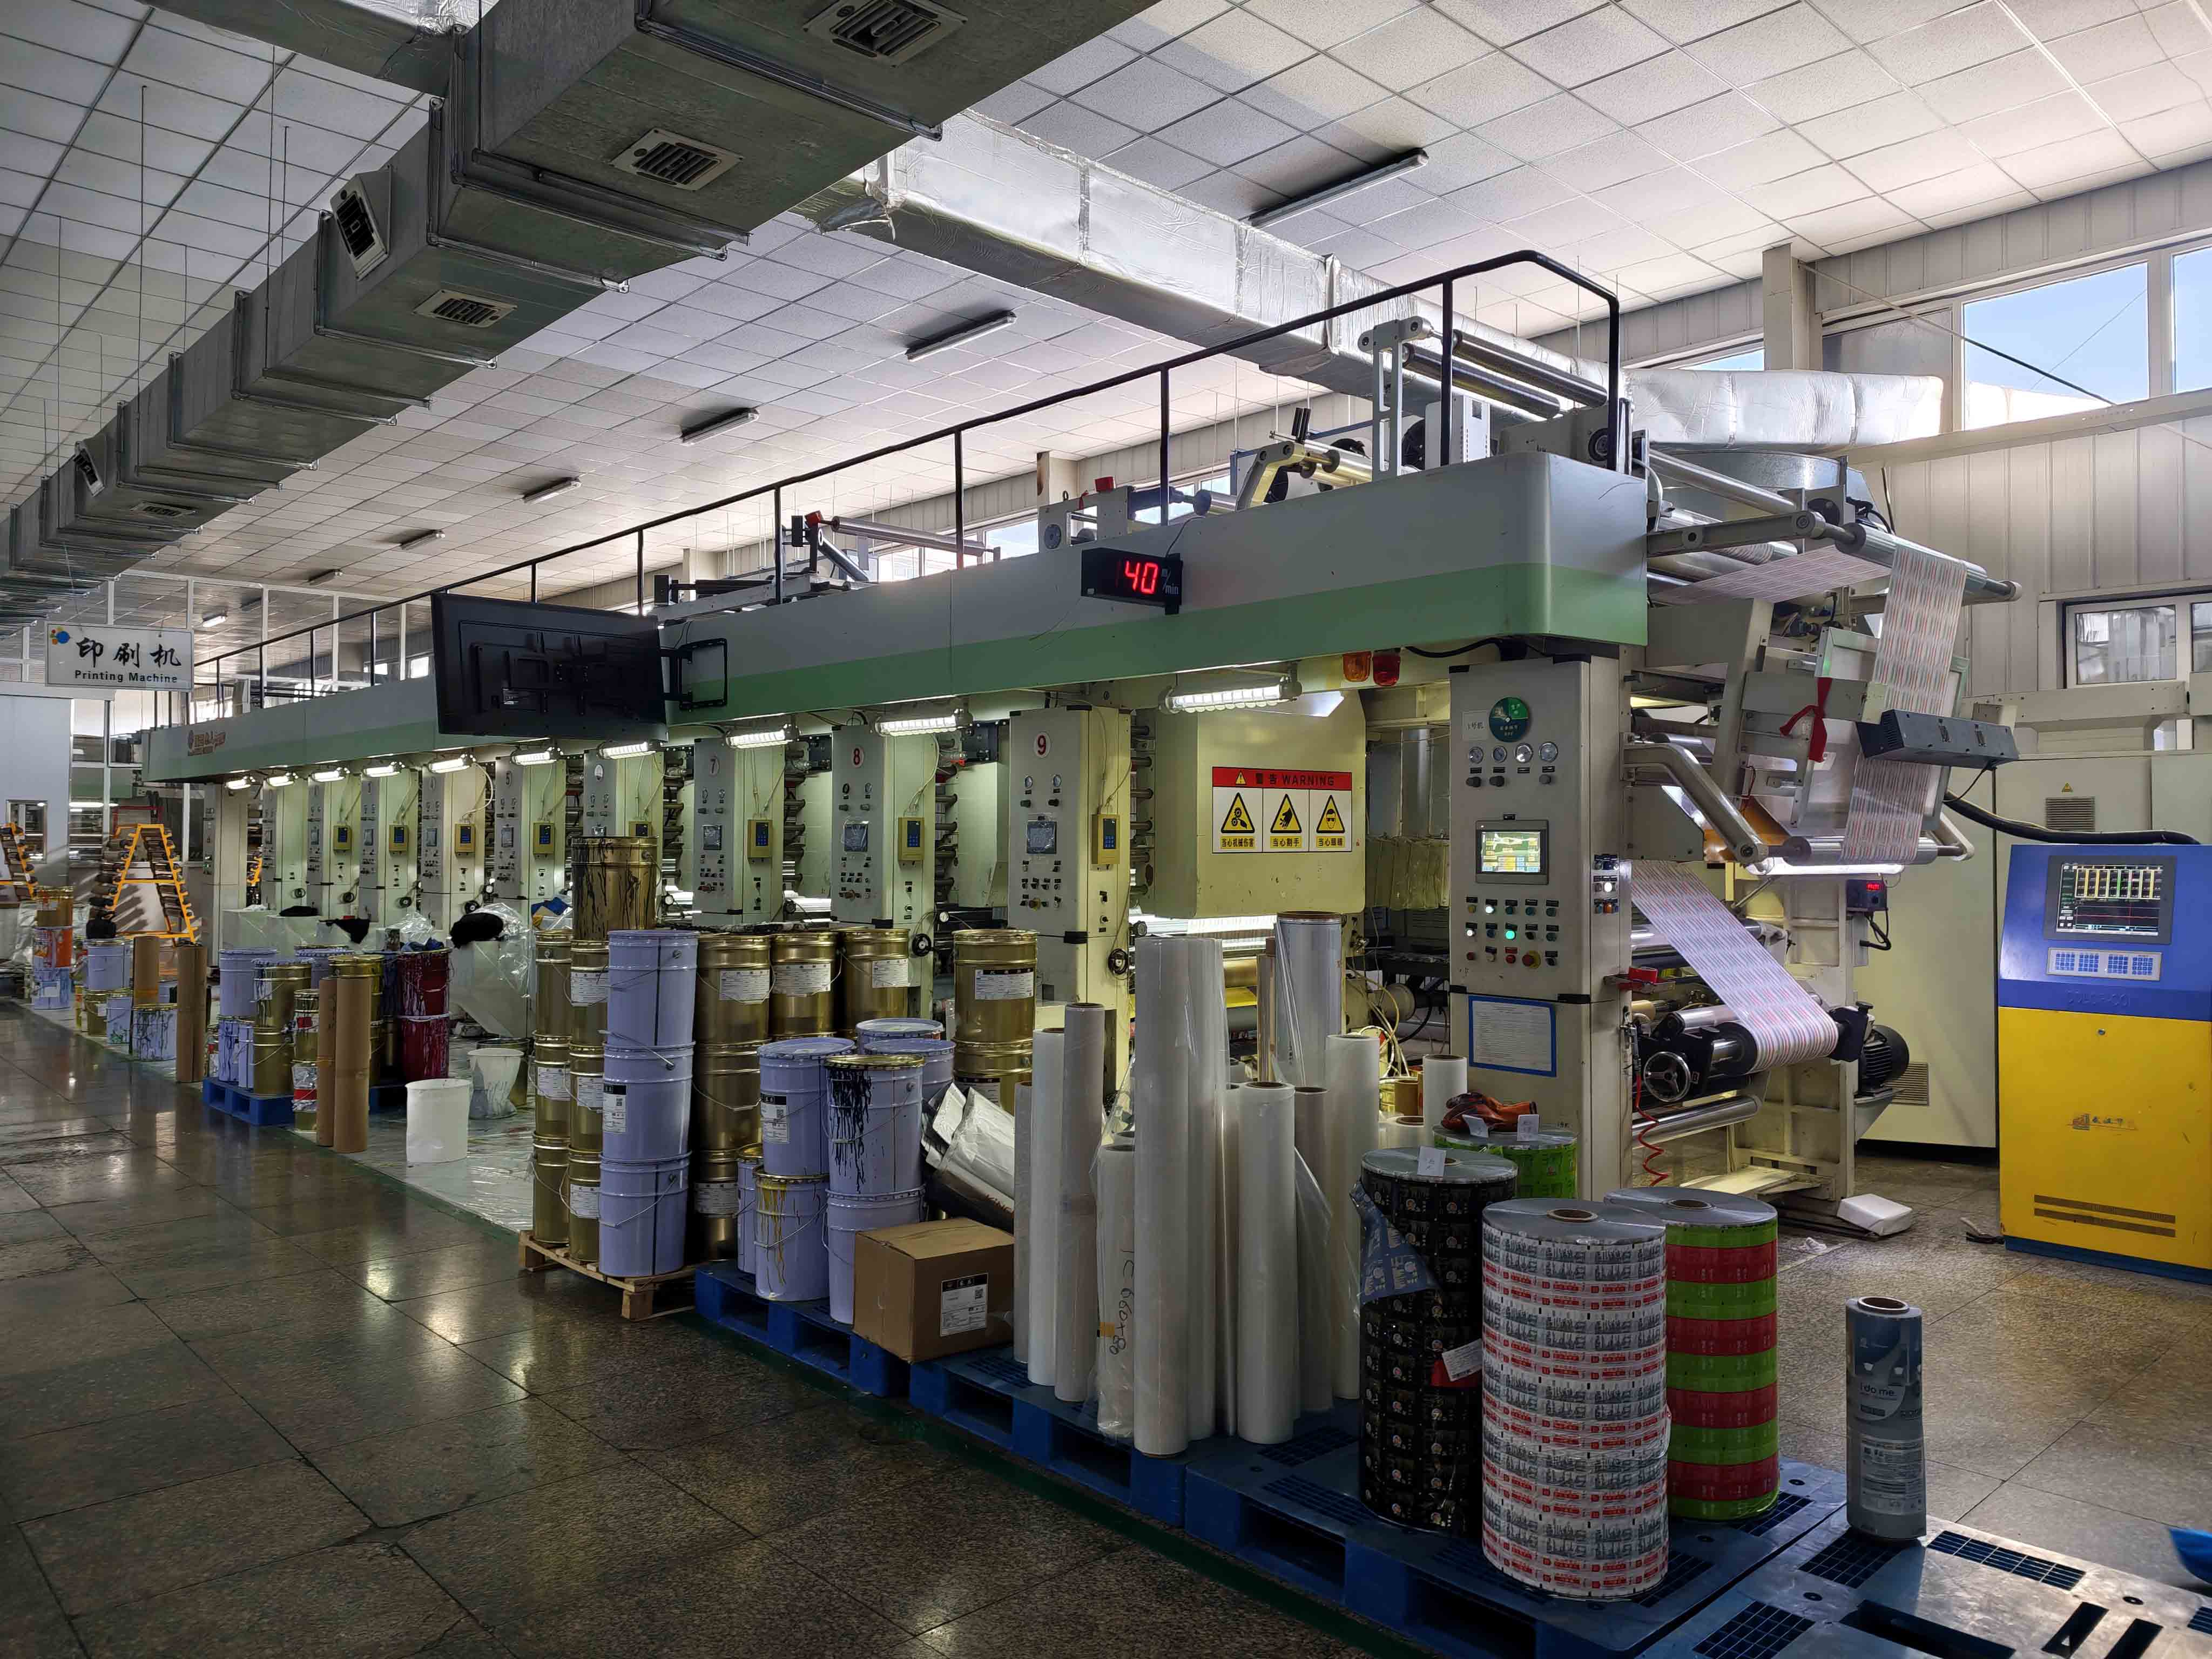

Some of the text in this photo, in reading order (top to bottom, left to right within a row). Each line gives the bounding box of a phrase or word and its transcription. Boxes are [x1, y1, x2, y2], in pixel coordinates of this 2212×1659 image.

[1124, 559, 1159, 595] 40
[76, 637, 181, 668] 印刷机
[75, 670, 178, 683] Printing Machine
[1037, 734, 1046, 756] 9
[853, 747, 860, 765] 8
[710, 758, 716, 774] 7
[505, 772, 510, 785] 5
[1256, 772, 1335, 786] 警告 WARNING
[1222, 838, 1255, 847] 当心机械伤害
